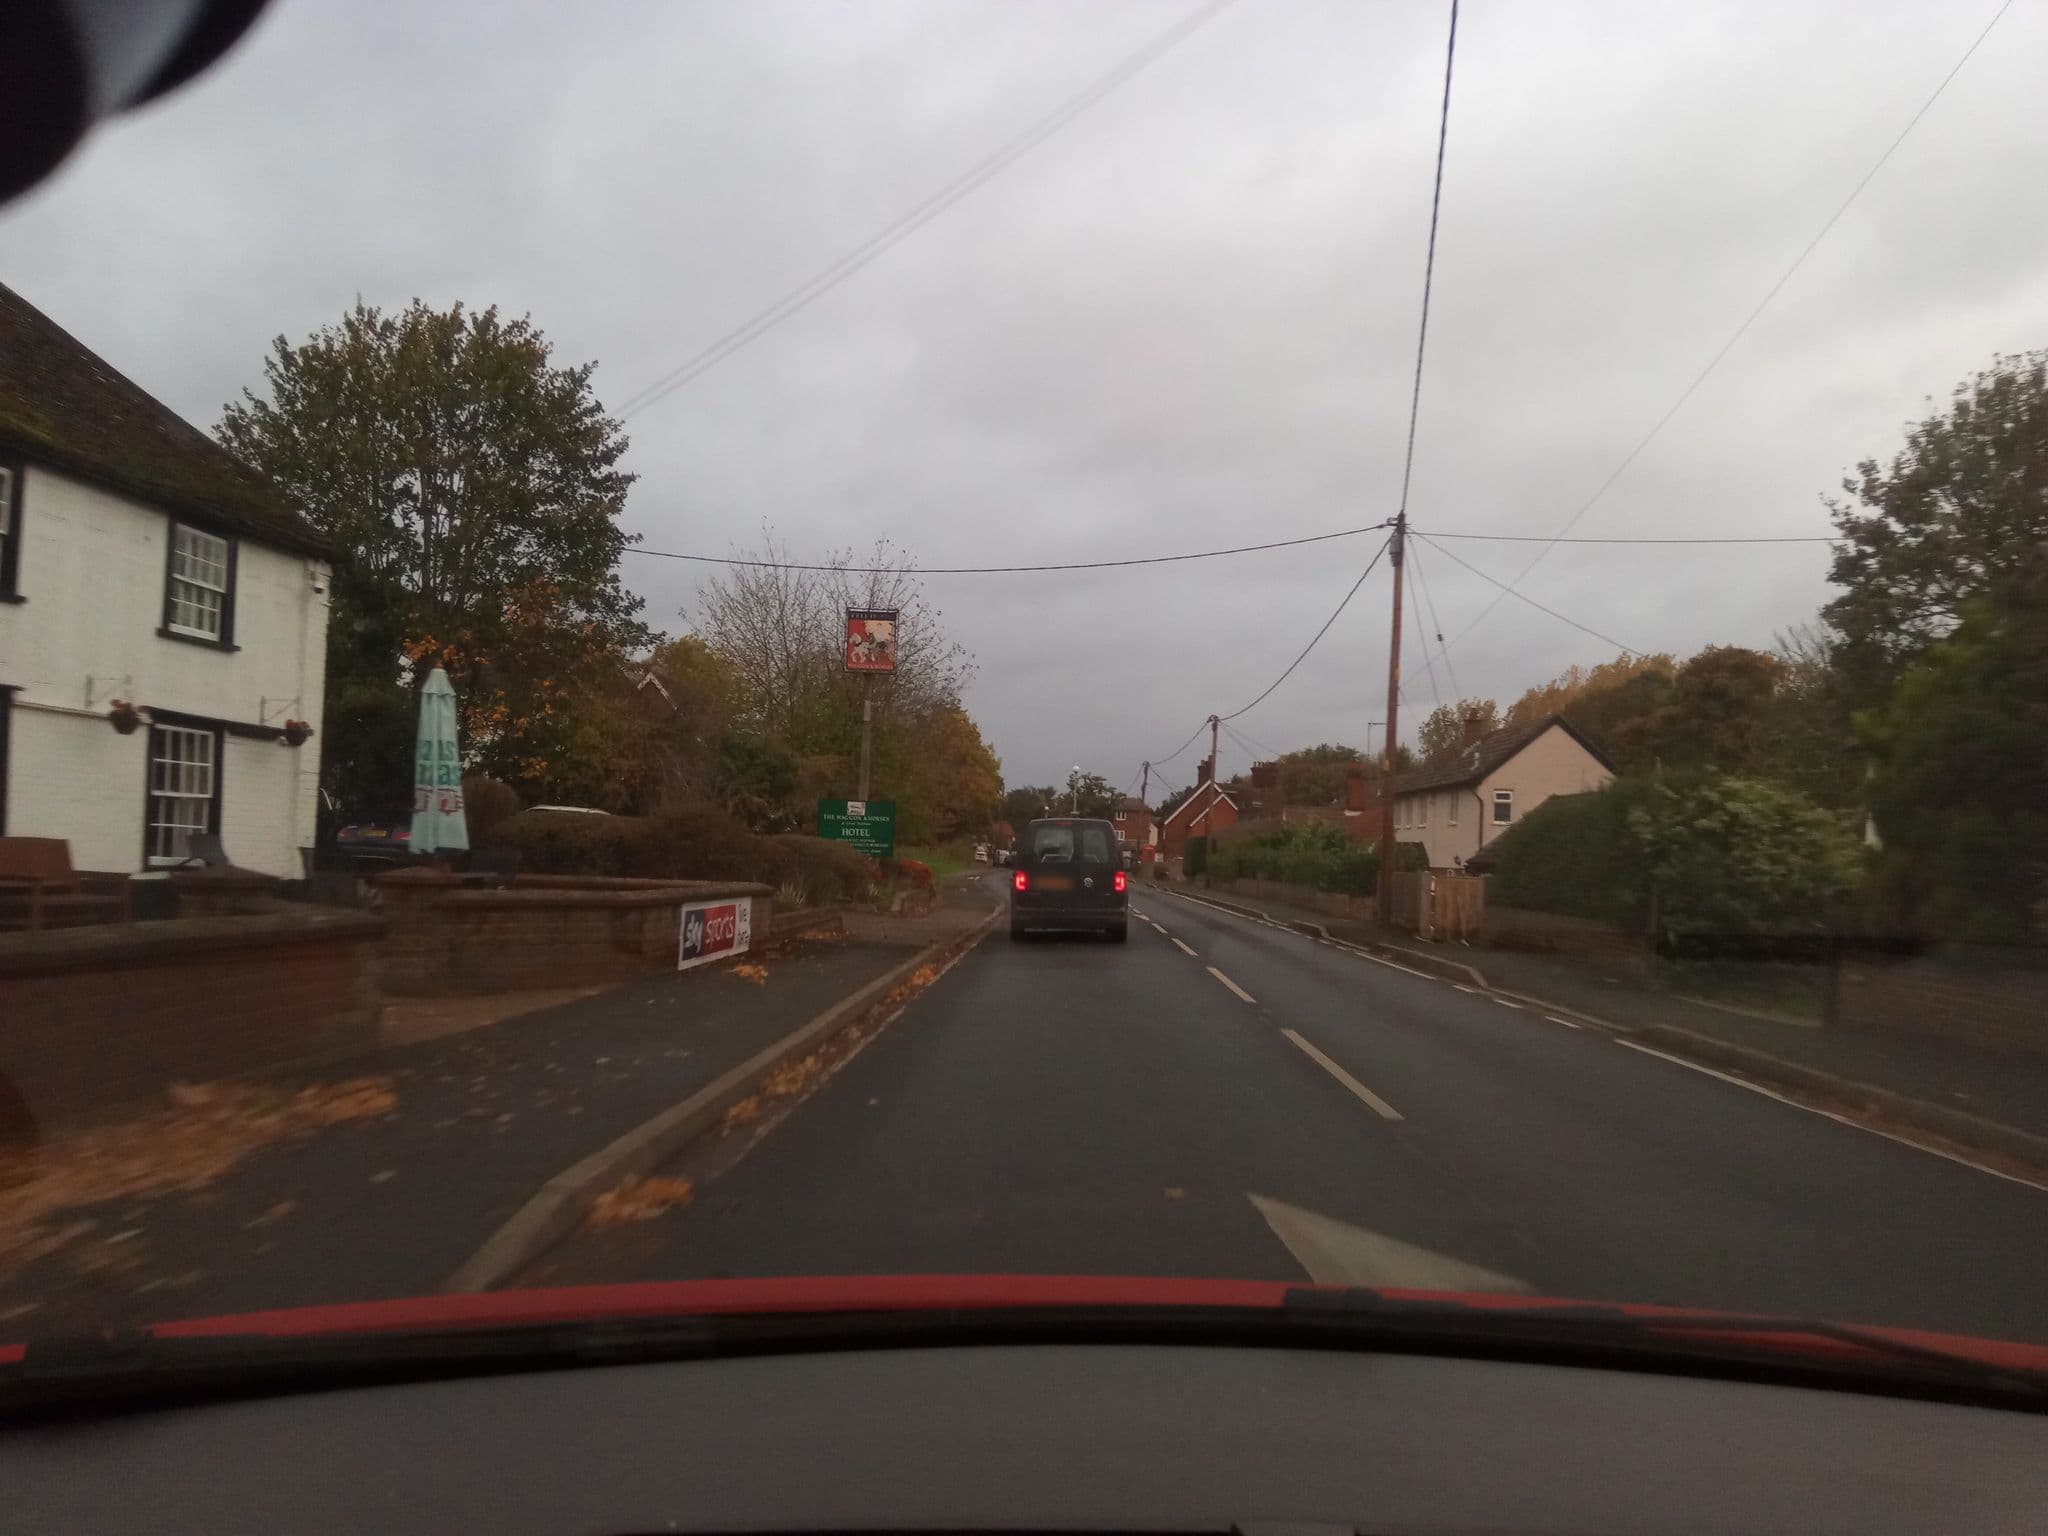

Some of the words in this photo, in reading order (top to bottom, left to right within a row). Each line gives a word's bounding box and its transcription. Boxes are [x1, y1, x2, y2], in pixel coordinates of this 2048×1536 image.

[841, 828, 871, 837] HOTEL
[684, 915, 703, 953] sky
[705, 914, 735, 951] sports
